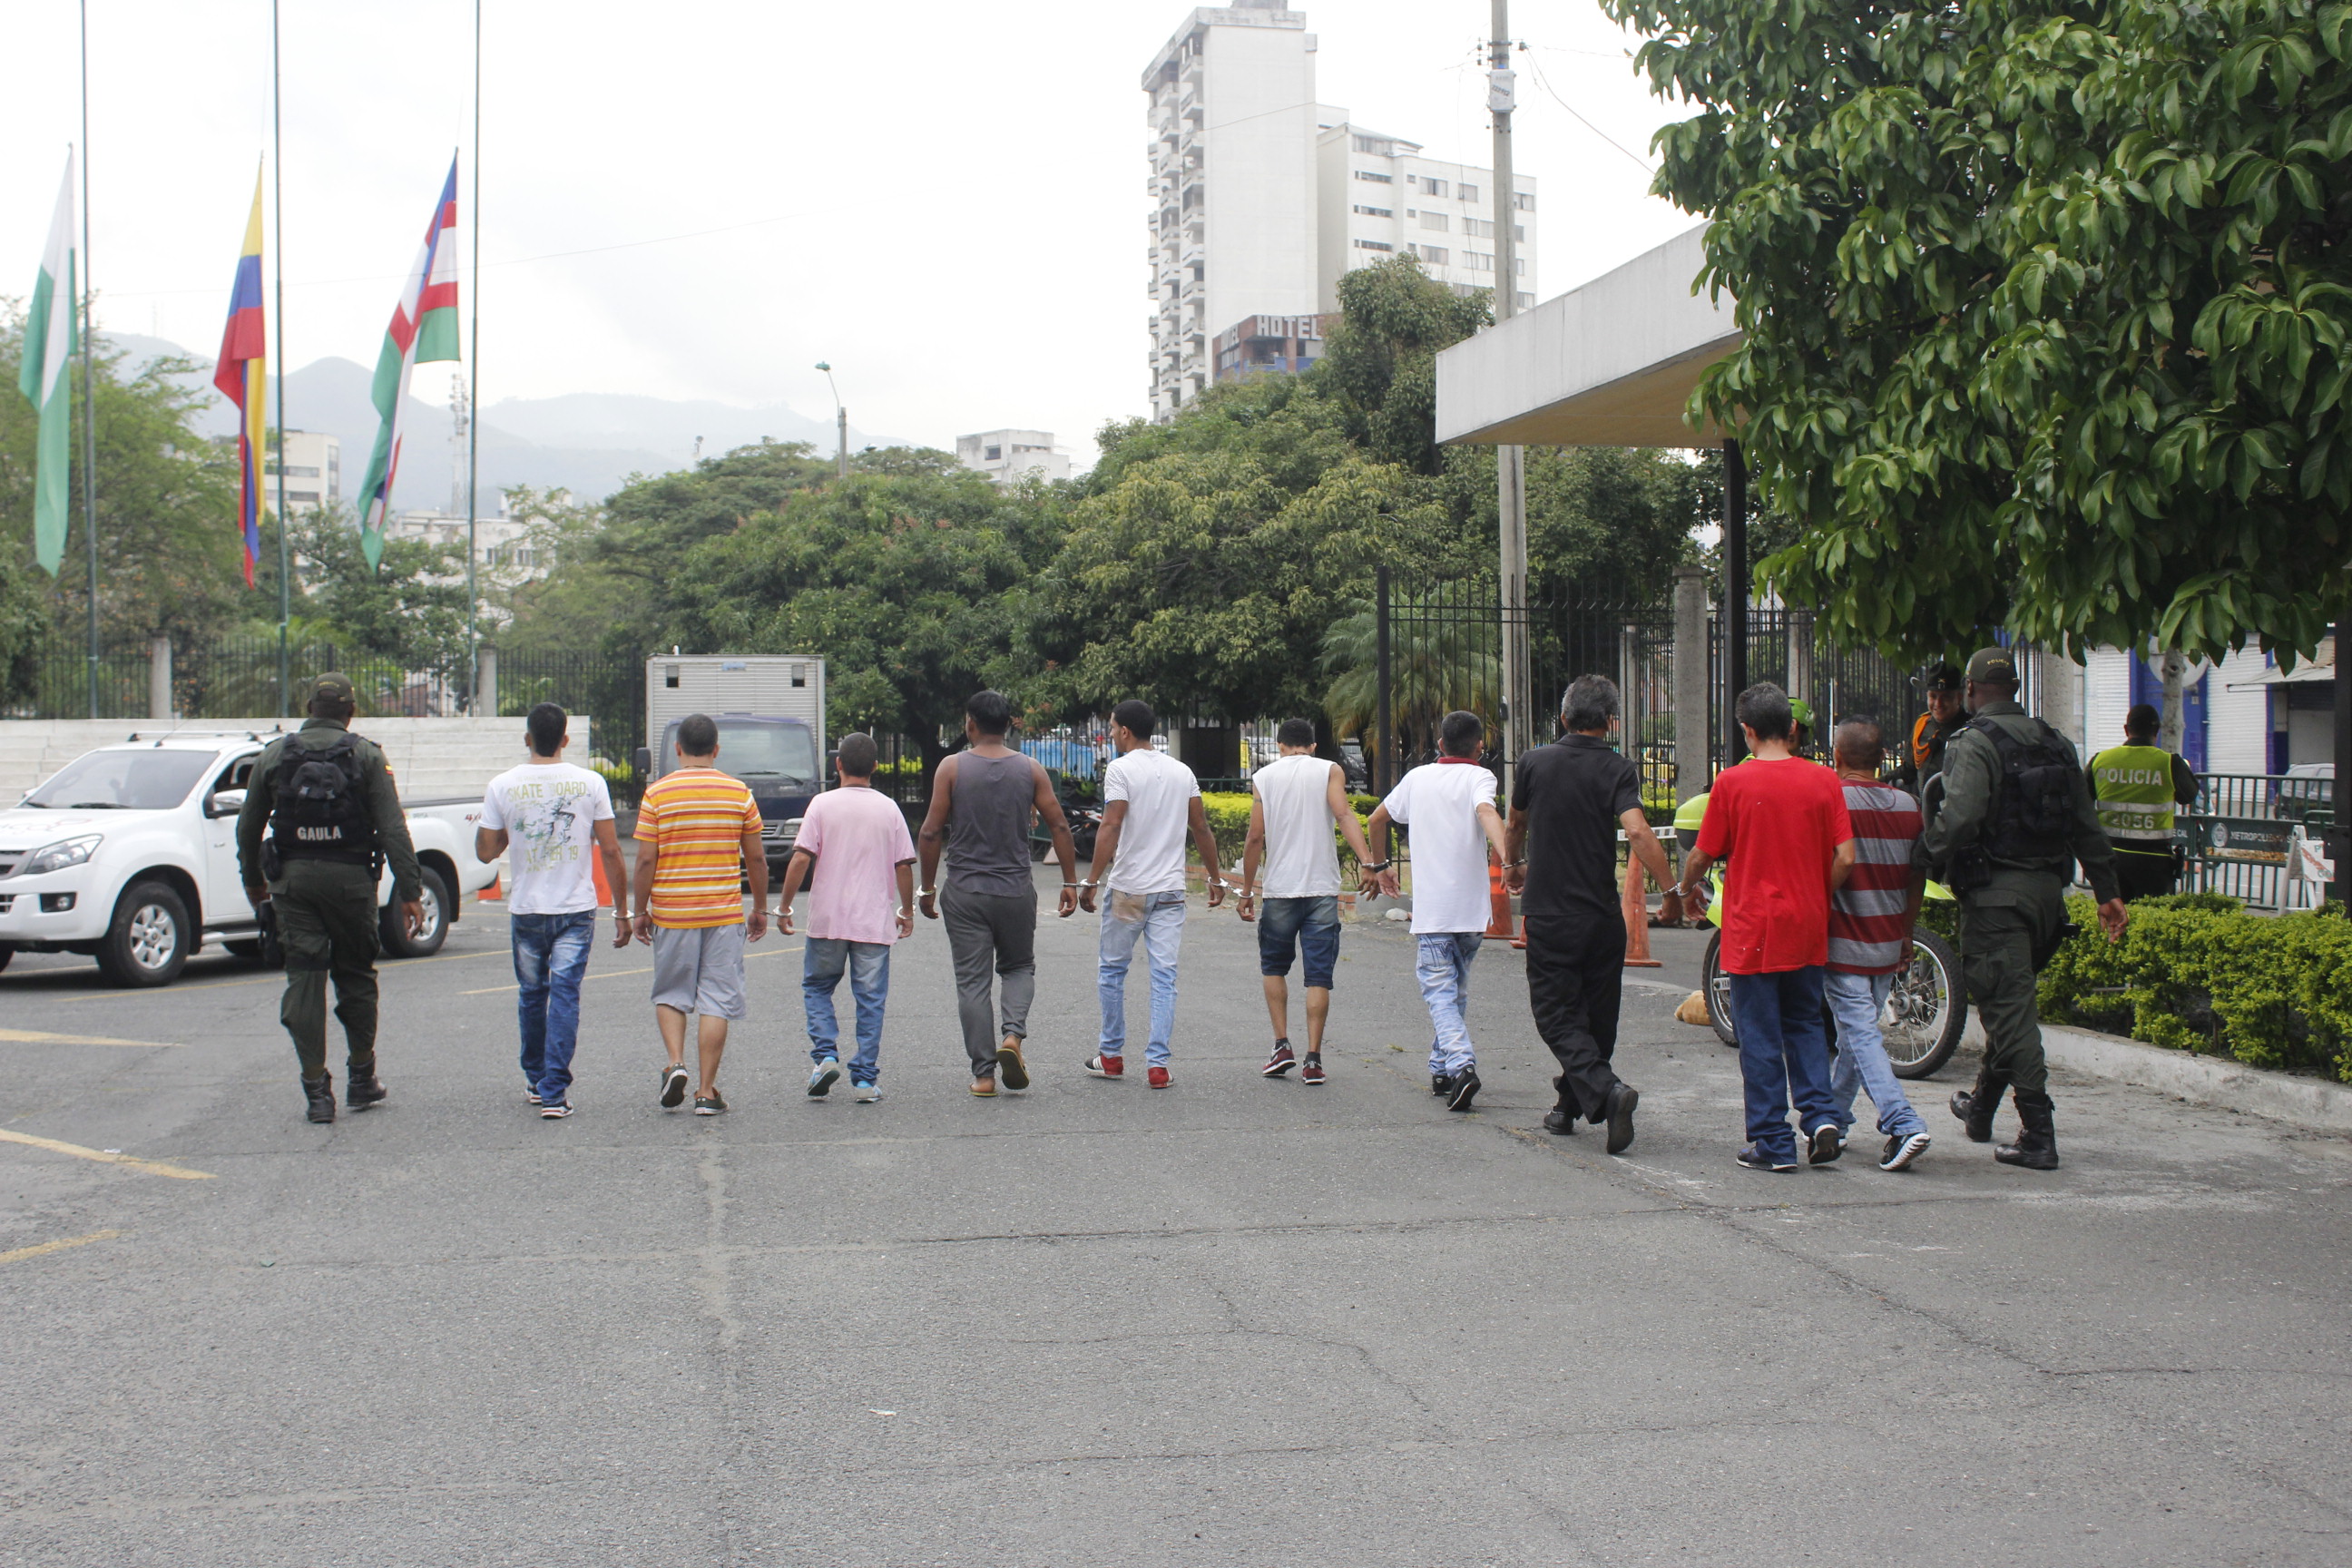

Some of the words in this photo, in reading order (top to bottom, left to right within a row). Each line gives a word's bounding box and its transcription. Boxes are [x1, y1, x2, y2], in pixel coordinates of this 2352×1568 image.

[1257, 315, 1323, 340] HOTEL
[2097, 767, 2163, 787] POLICIA
[508, 783, 544, 802] SKATE
[297, 825, 342, 841] GAULA
[569, 844, 579, 861] 19
